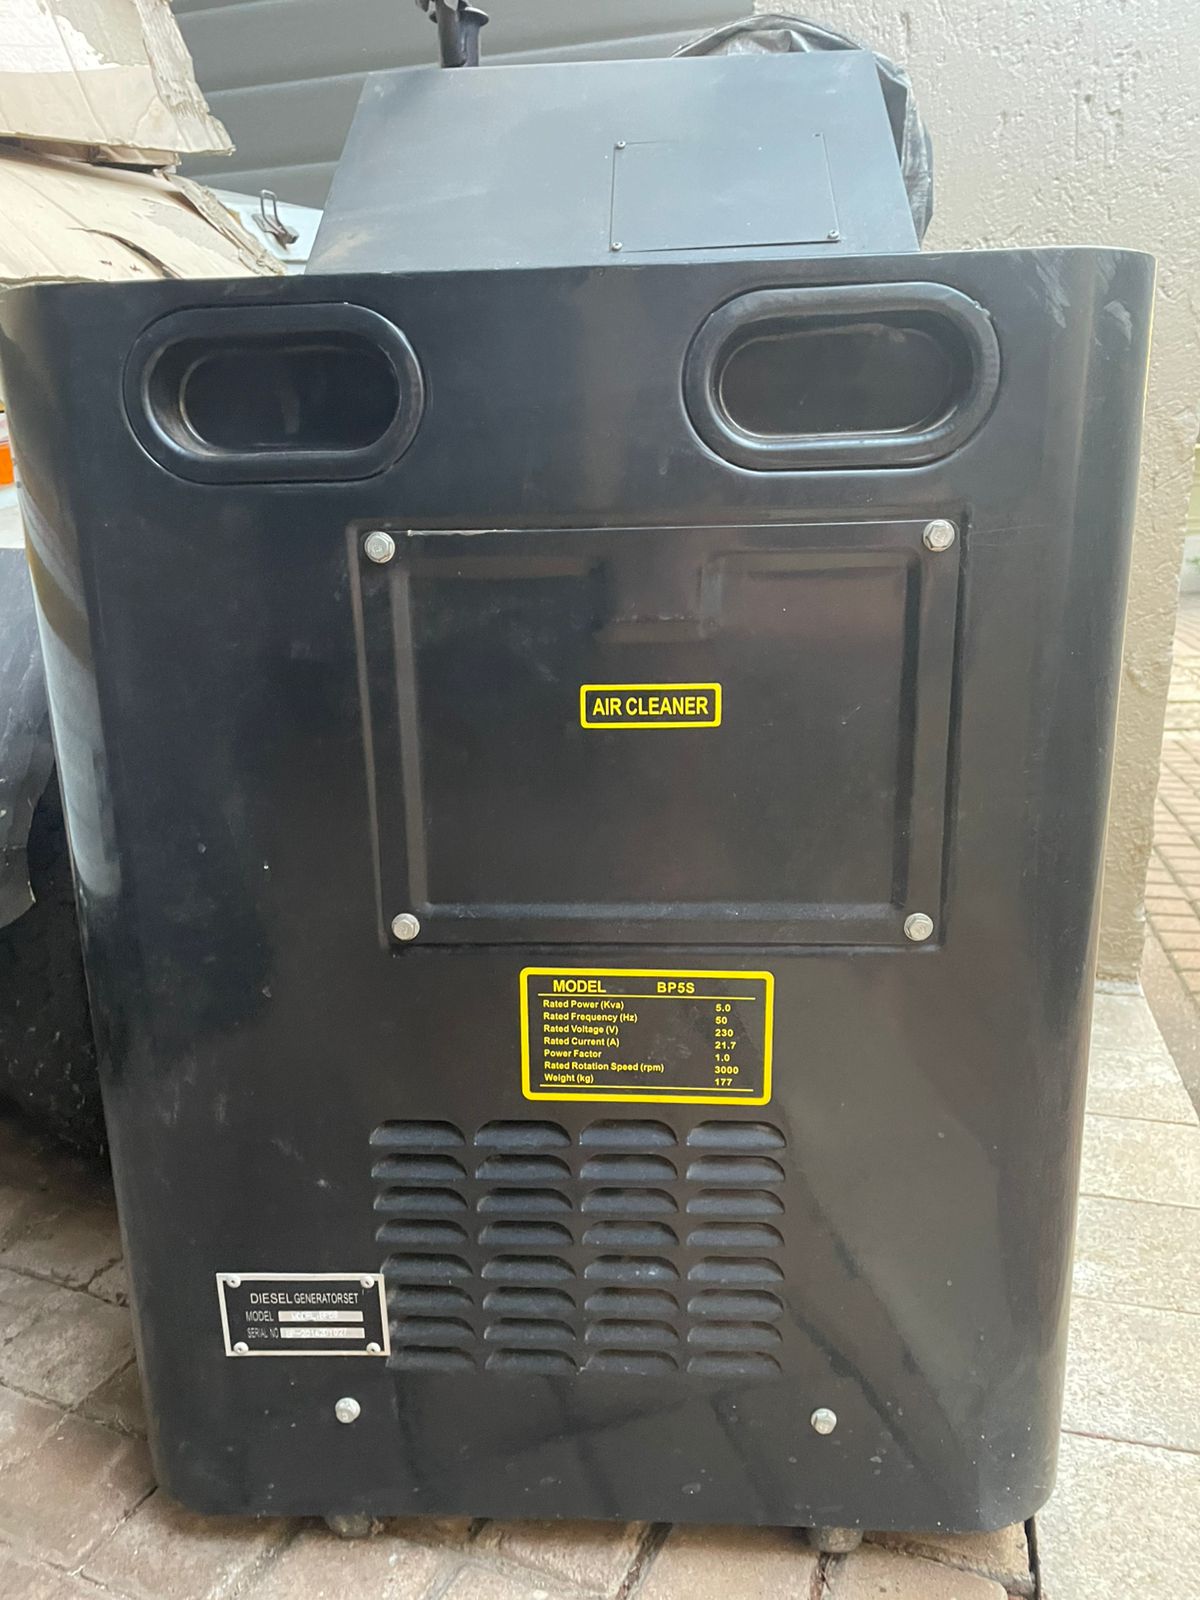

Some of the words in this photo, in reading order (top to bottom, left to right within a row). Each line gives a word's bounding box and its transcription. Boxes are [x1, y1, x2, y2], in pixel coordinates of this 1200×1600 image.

[592, 698, 622, 716] AIR
[626, 697, 708, 715] CLEANER
[553, 980, 606, 993] MODEL
[657, 982, 695, 993] BP5S
[543, 1000, 568, 1008] Rated
[571, 1000, 599, 1008] Power
[601, 1001, 624, 1010] (Kva)
[715, 1004, 731, 1012] 5.0
[543, 1012, 569, 1020] Rated
[571, 1012, 618, 1023] Frequency
[620, 1014, 638, 1023] (Hz)
[715, 1016, 727, 1024] 50
[543, 1024, 569, 1032] Rated
[571, 1025, 604, 1035] Voltage
[606, 1025, 618, 1035] (V)
[715, 1029, 733, 1037] 230
[544, 1037, 569, 1045] Rated
[571, 1037, 605, 1045] Current
[607, 1038, 619, 1047] (A)
[544, 1049, 571, 1057] Power
[715, 1054, 730, 1062] 1.0
[572, 1062, 609, 1070] Rotation
[611, 1063, 638, 1072] Speed
[640, 1063, 664, 1073] (rpm)
[715, 1066, 739, 1074] 3000
[544, 1073, 575, 1083] Weight
[576, 1074, 594, 1083] (kg)
[250, 1293, 293, 1304] DIESEL
[294, 1293, 358, 1304] GENERATORSET
[245, 1311, 274, 1322] MODEL
[247, 1328, 268, 1339] SERIAL
[271, 1328, 279, 1339] NO
